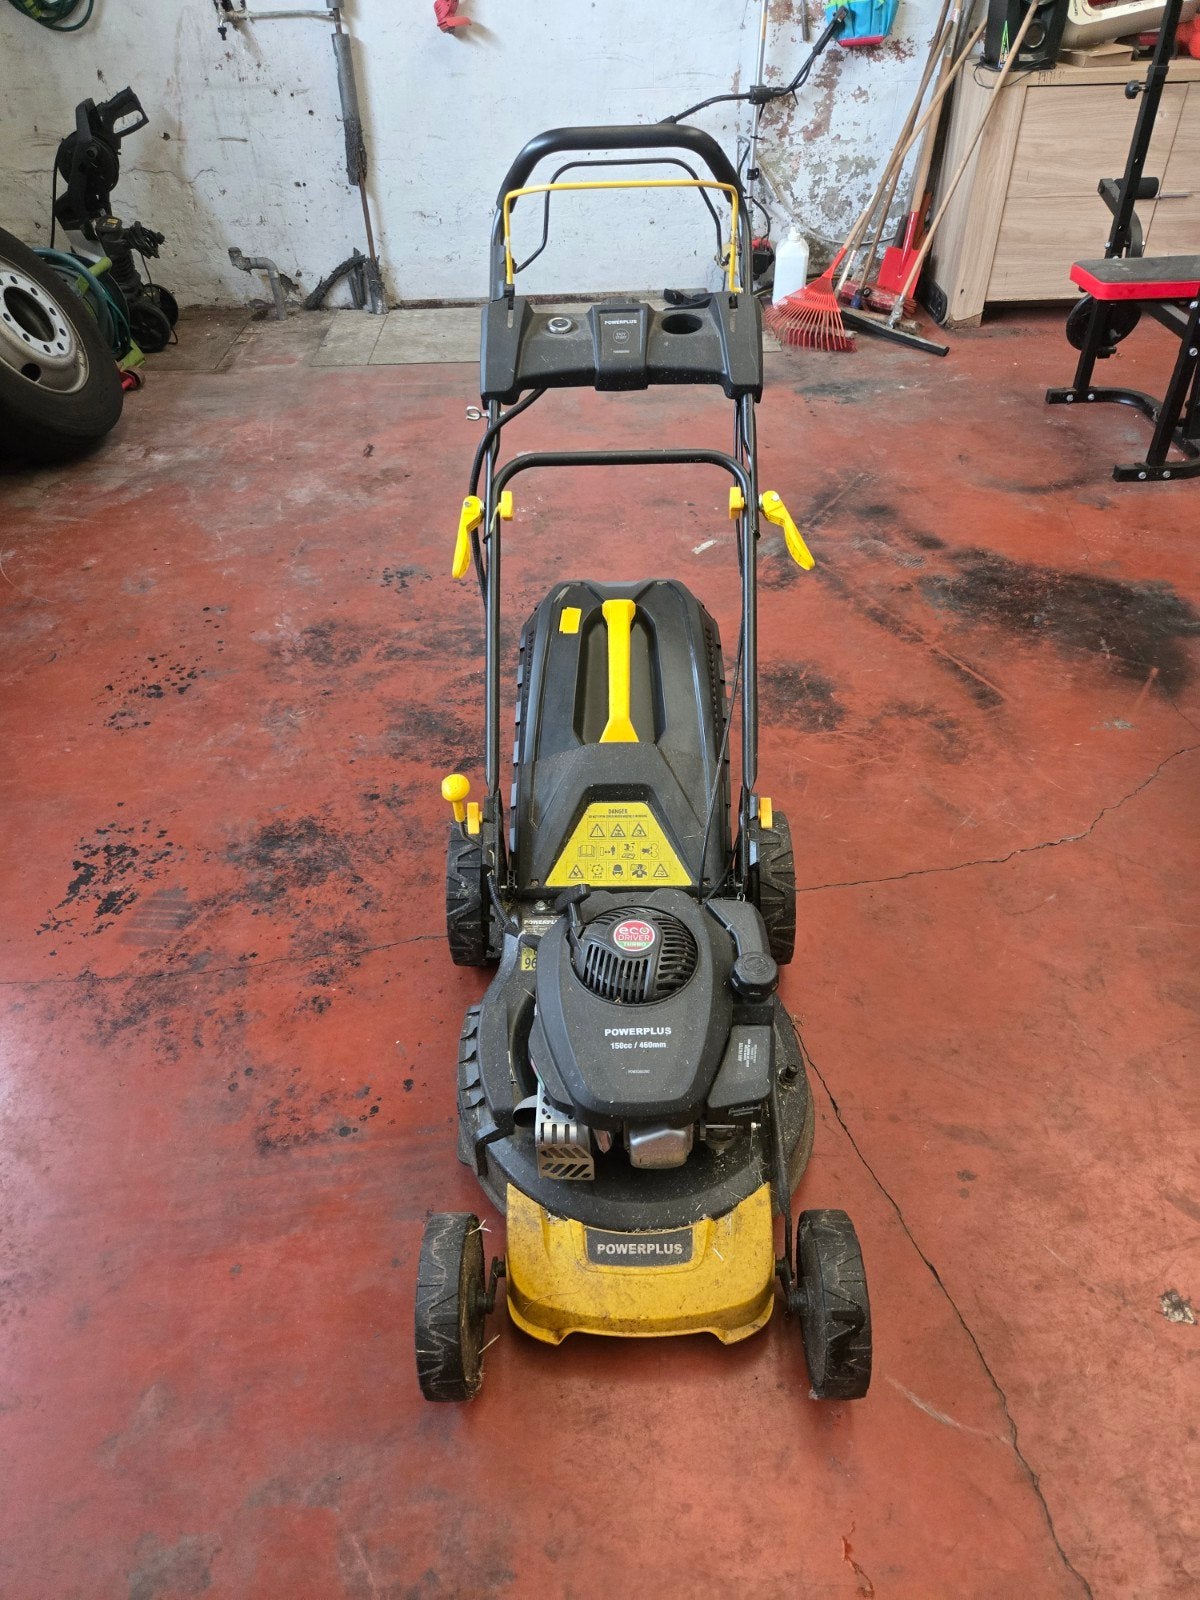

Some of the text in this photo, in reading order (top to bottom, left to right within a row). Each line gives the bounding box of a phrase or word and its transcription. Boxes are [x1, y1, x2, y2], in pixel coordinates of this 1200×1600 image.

[604, 1027, 672, 1036] POWERPLUS
[610, 1041, 667, 1050] 150cc / 460mm
[597, 1243, 683, 1255] POWERPLUS
